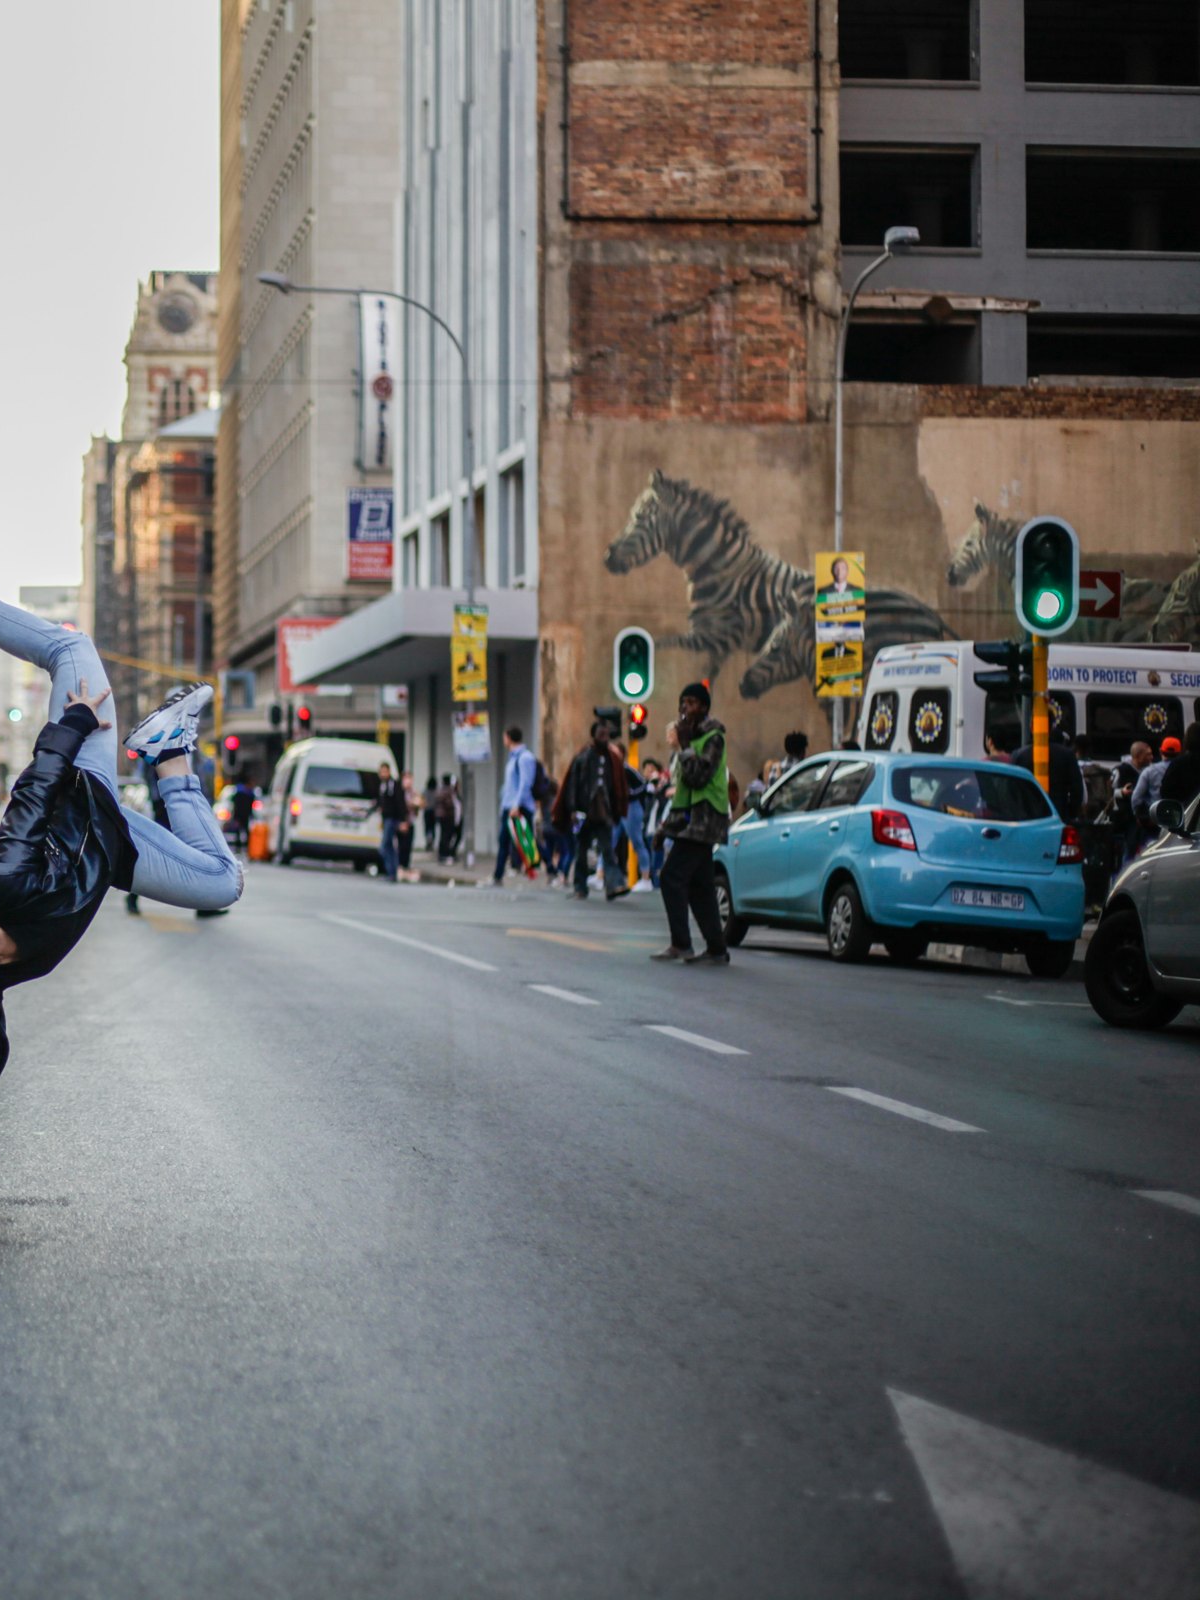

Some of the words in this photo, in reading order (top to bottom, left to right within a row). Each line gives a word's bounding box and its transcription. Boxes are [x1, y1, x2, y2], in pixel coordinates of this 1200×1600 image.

[1077, 668, 1089, 682] TO
[1092, 669, 1138, 684] PROTECT
[1011, 894, 1023, 908] GP
